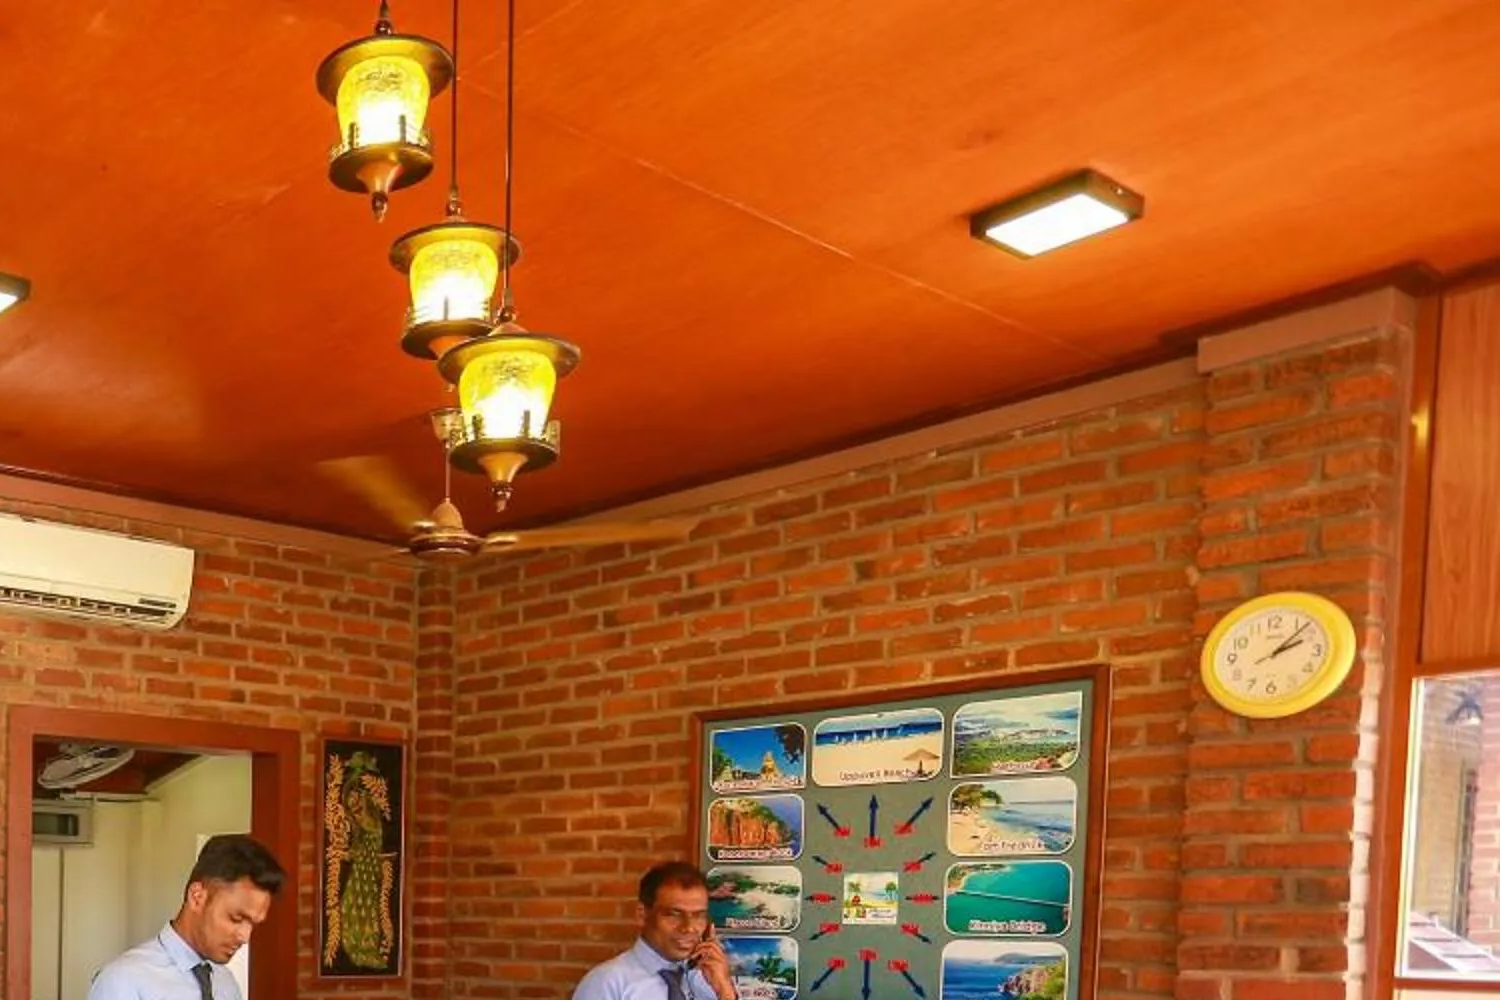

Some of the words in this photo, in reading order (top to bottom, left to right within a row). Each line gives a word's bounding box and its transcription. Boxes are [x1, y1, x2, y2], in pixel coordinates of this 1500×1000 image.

[1267, 614, 1283, 632] 12
[1233, 636, 1249, 652] 10
[1311, 643, 1322, 658] 3
[1227, 652, 1238, 665] 9
[1245, 677, 1257, 692] 7
[1265, 680, 1277, 695] 6
